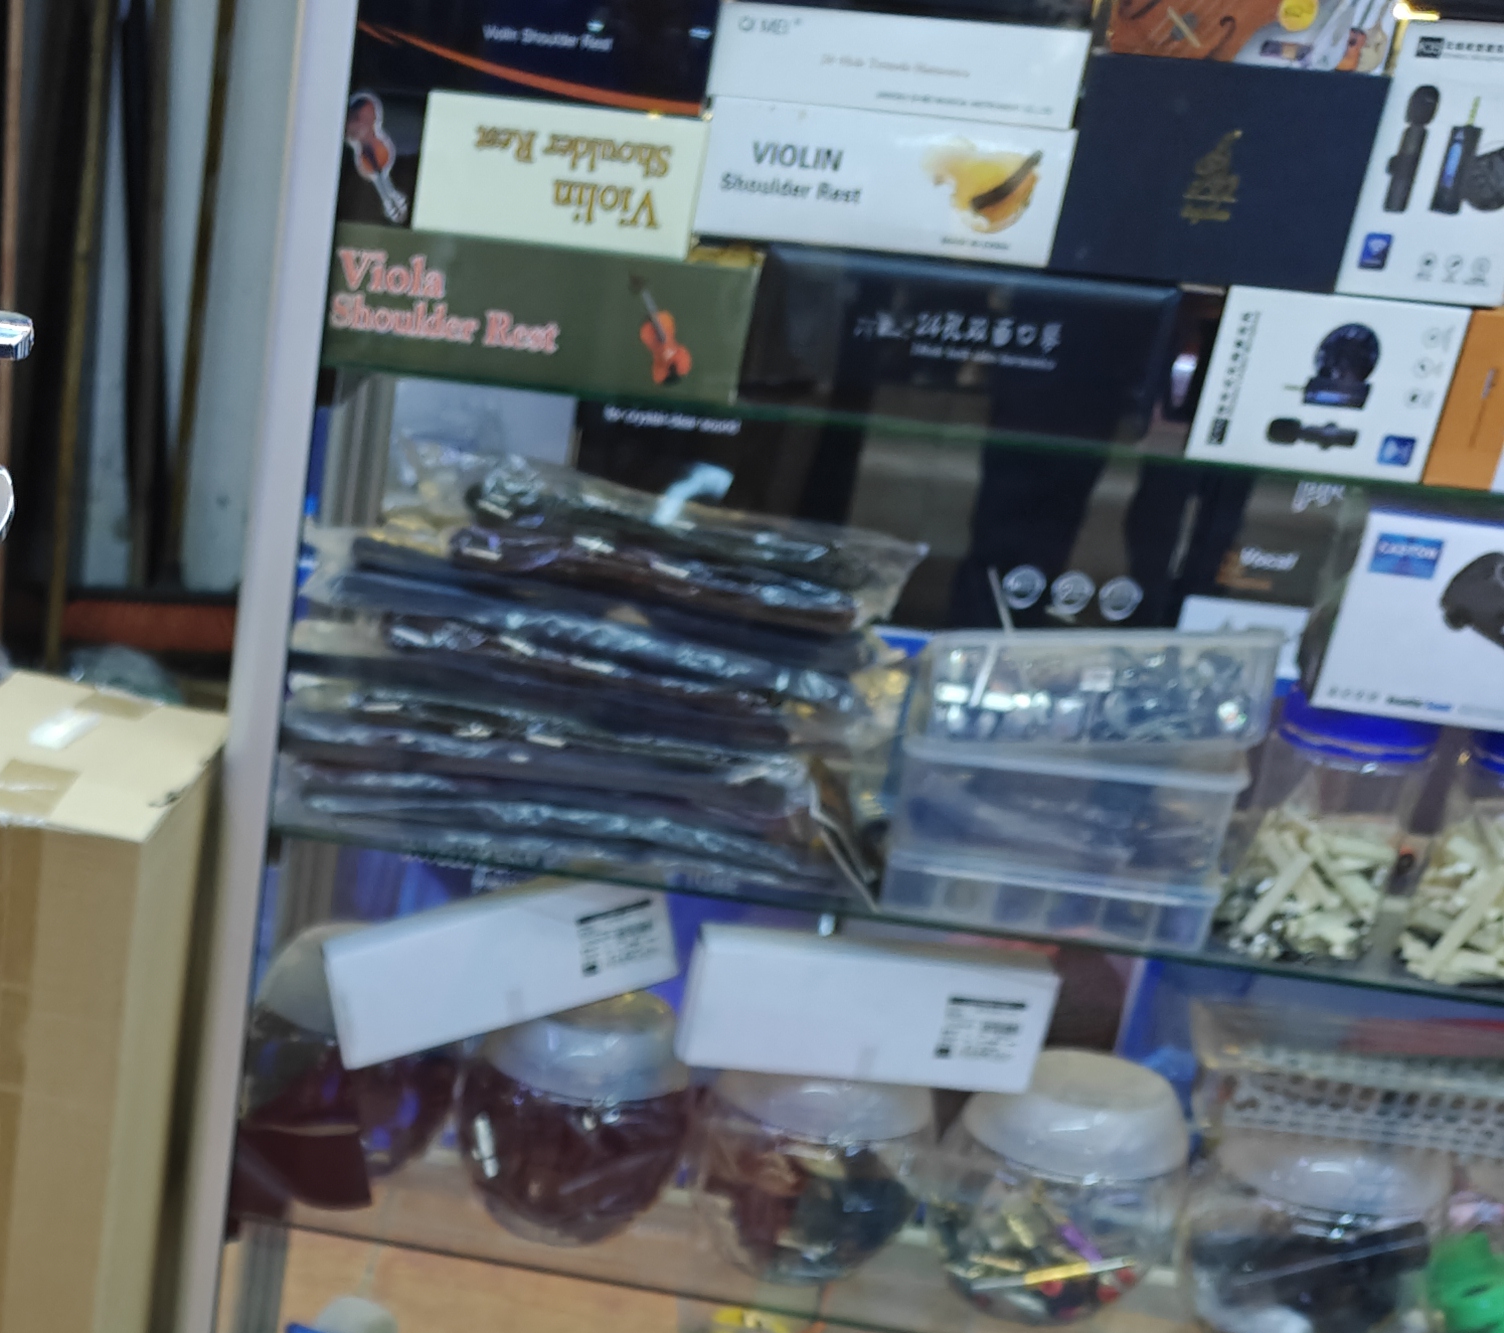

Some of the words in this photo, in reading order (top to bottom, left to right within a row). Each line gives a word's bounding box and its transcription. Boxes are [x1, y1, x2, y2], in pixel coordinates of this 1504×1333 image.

[475, 125, 536, 164] Rest
[543, 133, 672, 178] Shoulder
[753, 140, 844, 172] VIOLIN
[554, 179, 658, 229] Violin
[721, 172, 813, 201] Shoulder
[817, 183, 863, 204] Rest
[338, 248, 445, 299] Viola
[330, 292, 480, 344] Shoulder
[482, 309, 560, 356] Rest
